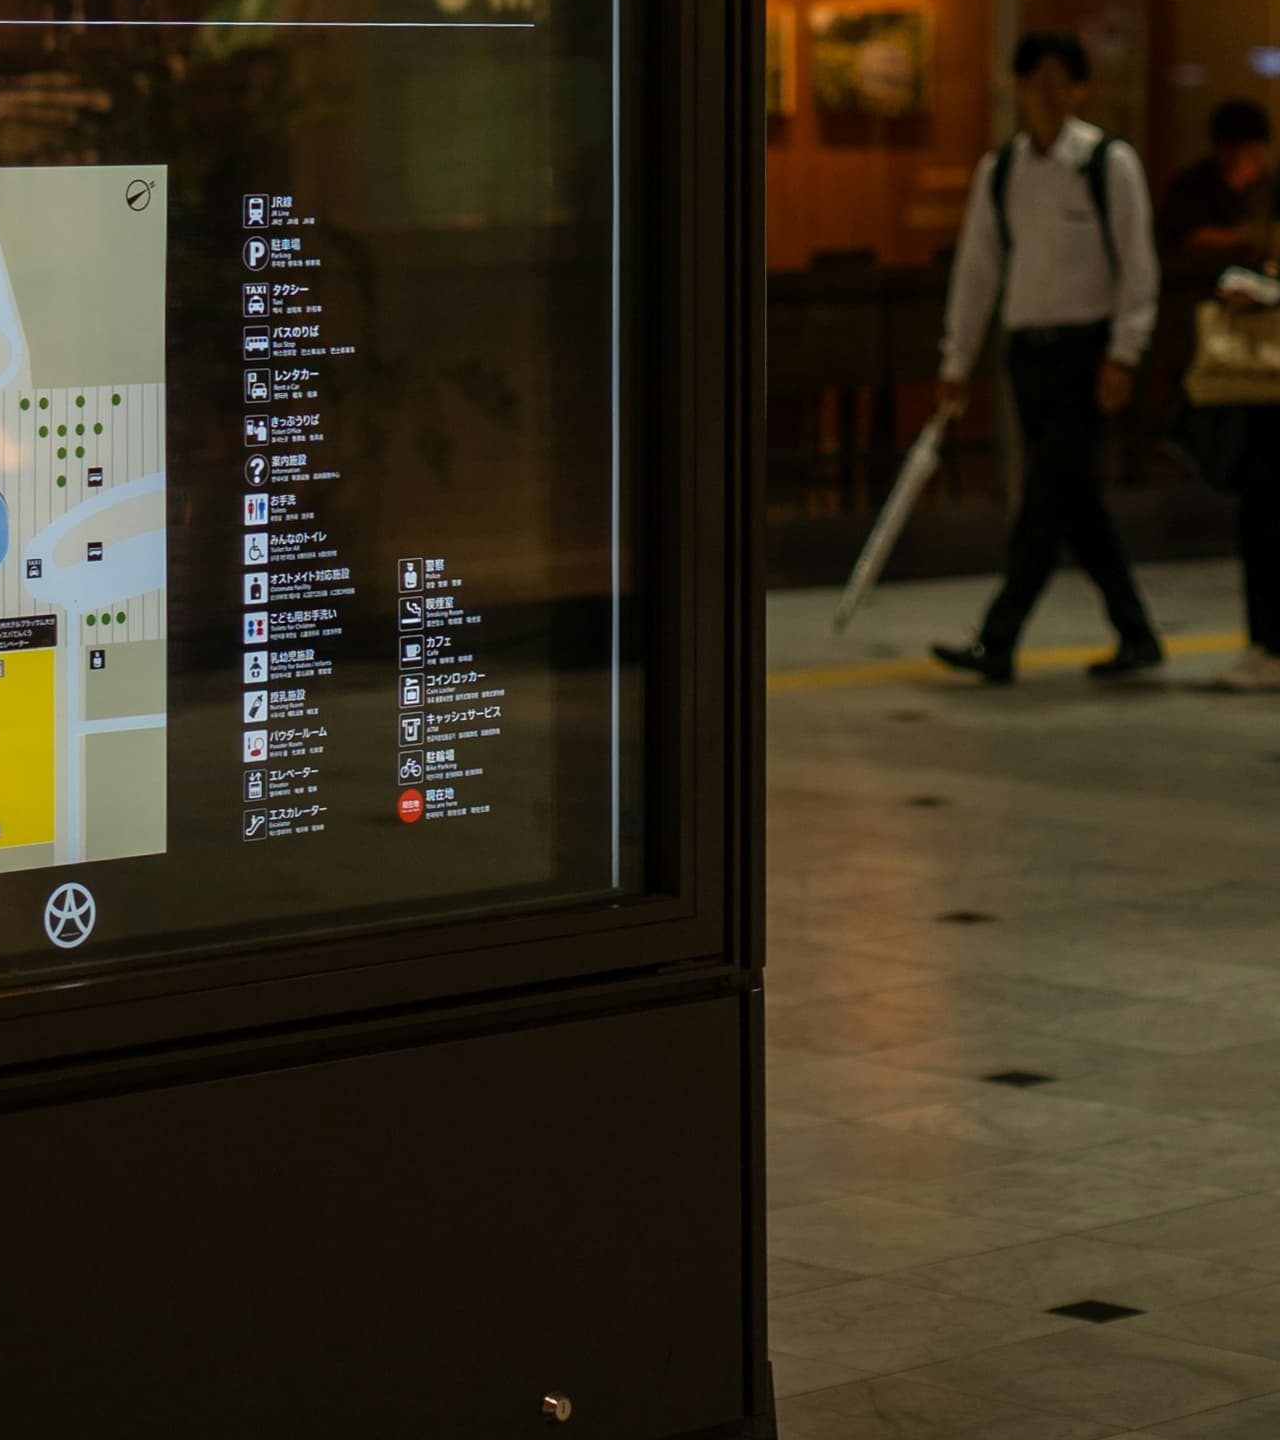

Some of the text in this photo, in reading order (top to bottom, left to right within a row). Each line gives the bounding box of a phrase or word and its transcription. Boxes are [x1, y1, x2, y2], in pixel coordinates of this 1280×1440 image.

[245, 285, 267, 295] TAXI
[272, 284, 310, 296] タクシー
[273, 325, 320, 338] バスのりば
[274, 369, 320, 382] レンタカー
[270, 530, 328, 546] みんなのトイレ
[426, 635, 453, 649] カフェ
[426, 671, 487, 687] コインロッカー
[426, 705, 502, 725] キャッシュサービス
[269, 766, 320, 782] エレベーター
[269, 804, 328, 821] エスカレーター
